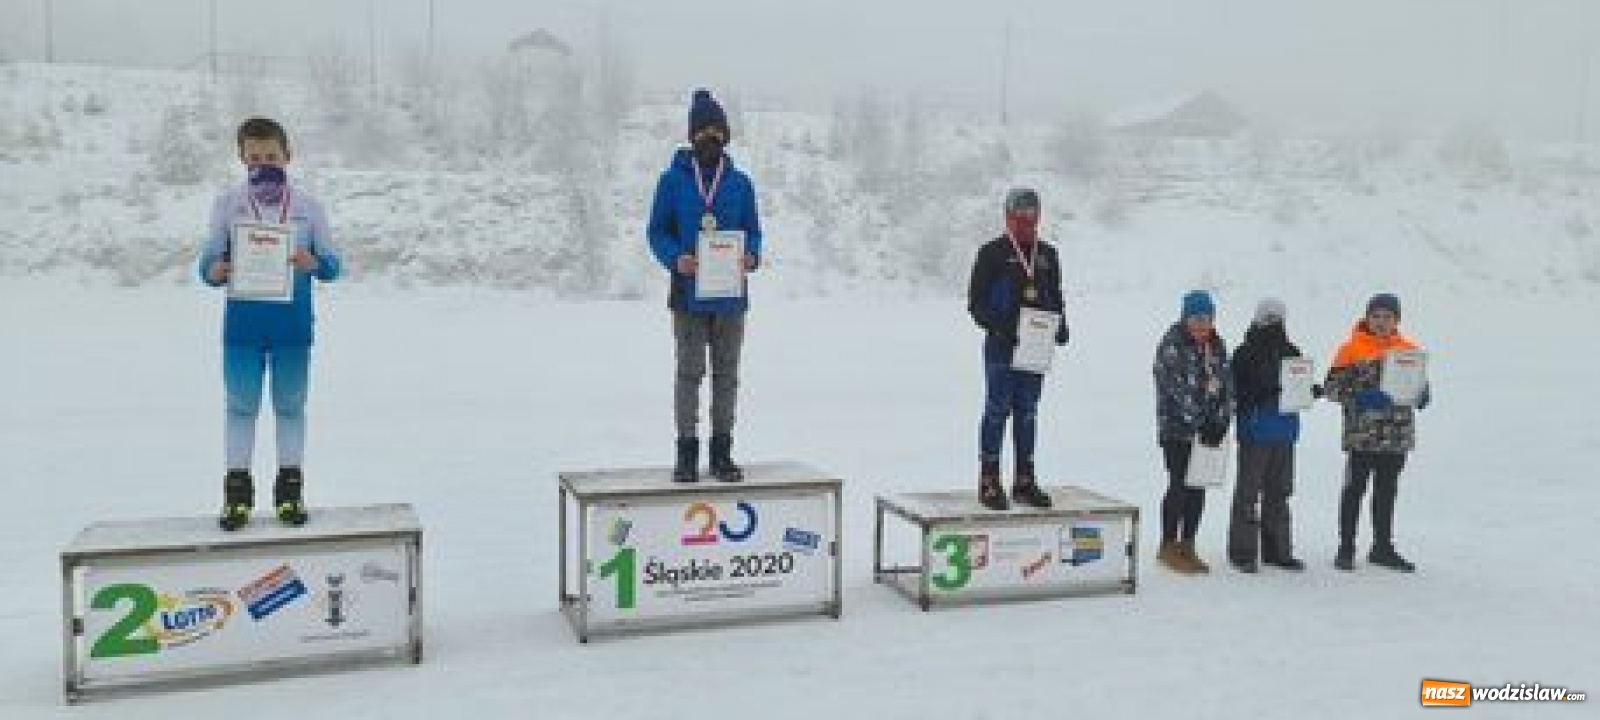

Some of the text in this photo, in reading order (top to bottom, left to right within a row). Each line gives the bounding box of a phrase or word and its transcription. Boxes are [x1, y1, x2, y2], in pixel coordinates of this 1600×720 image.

[600, 549, 636, 609] 1
[643, 552, 794, 587] Śląskie 2020
[932, 534, 972, 591] 3
[90, 583, 160, 658] 2
[161, 604, 218, 630] LOTTO
